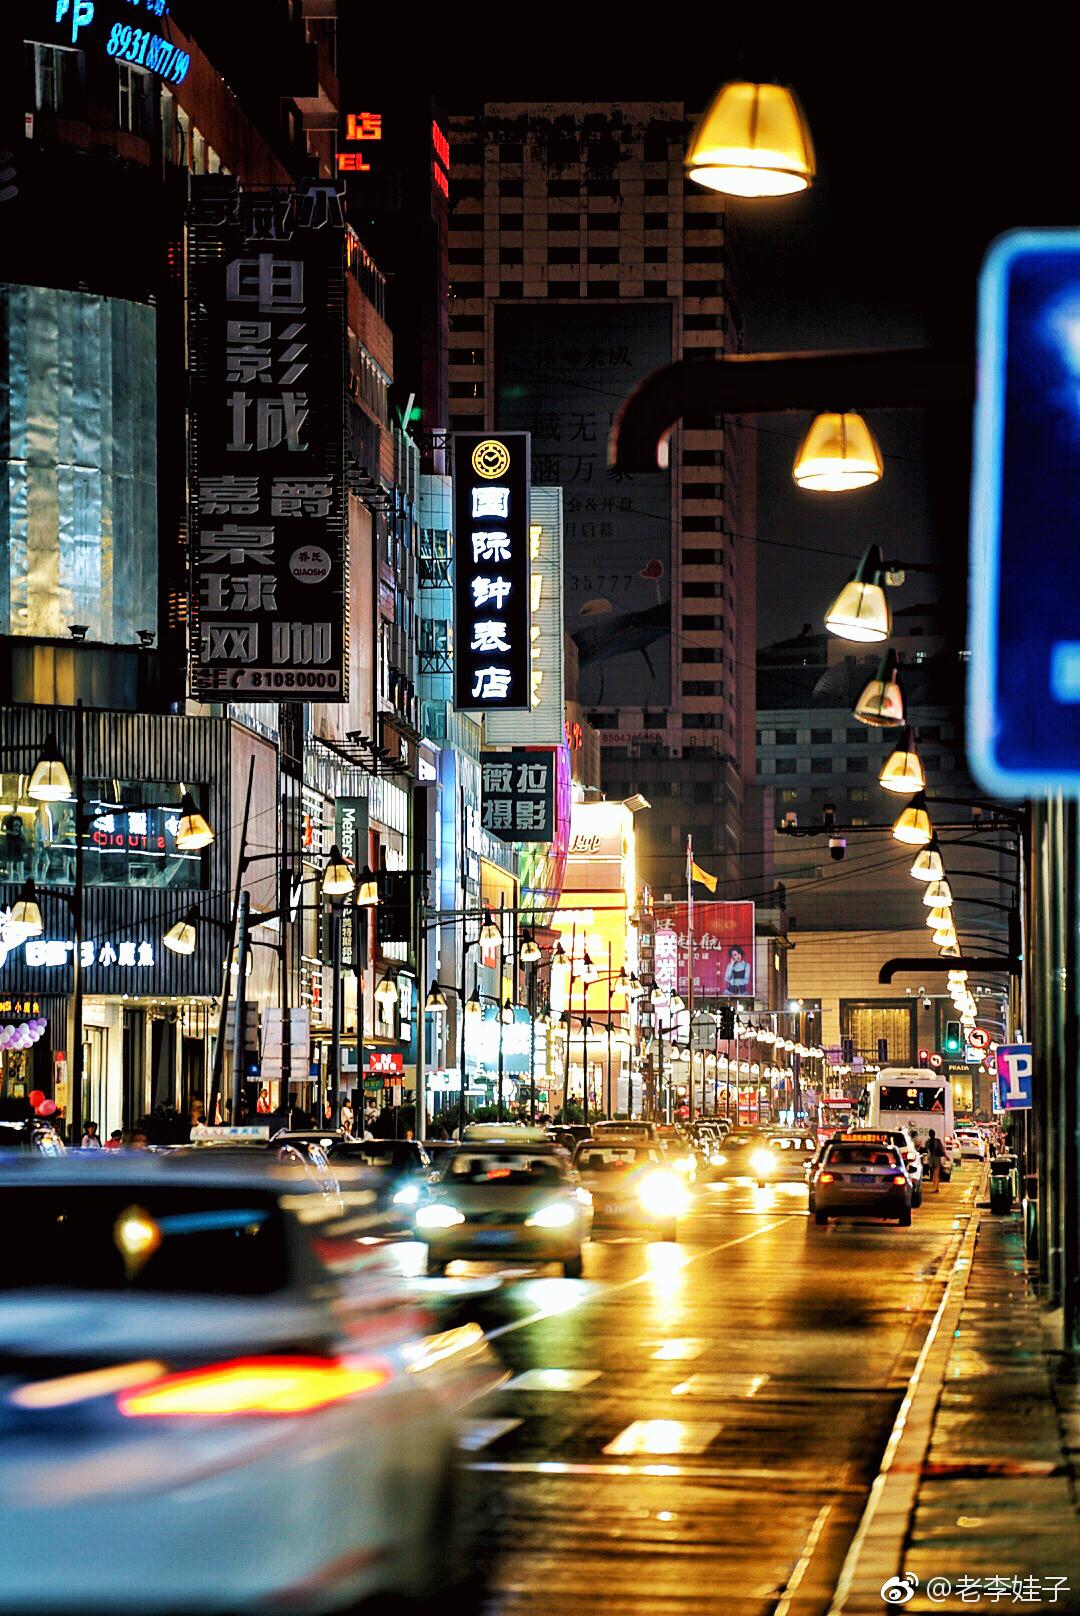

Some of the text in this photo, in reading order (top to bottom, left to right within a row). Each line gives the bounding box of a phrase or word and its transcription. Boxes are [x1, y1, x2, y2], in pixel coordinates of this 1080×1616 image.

[225, 252, 307, 453] 电影城
[197, 476, 333, 518] 嘉爵
[198, 523, 278, 613] 桌球
[293, 568, 327, 576] QIAOSHI
[470, 486, 513, 700] 国际钟表店
[199, 621, 332, 666] 网咖
[251, 672, 338, 688] 81080000
[482, 762, 548, 795] 薇拉
[482, 799, 547, 832] 摄影
[1004, 1054, 1033, 1100] P
